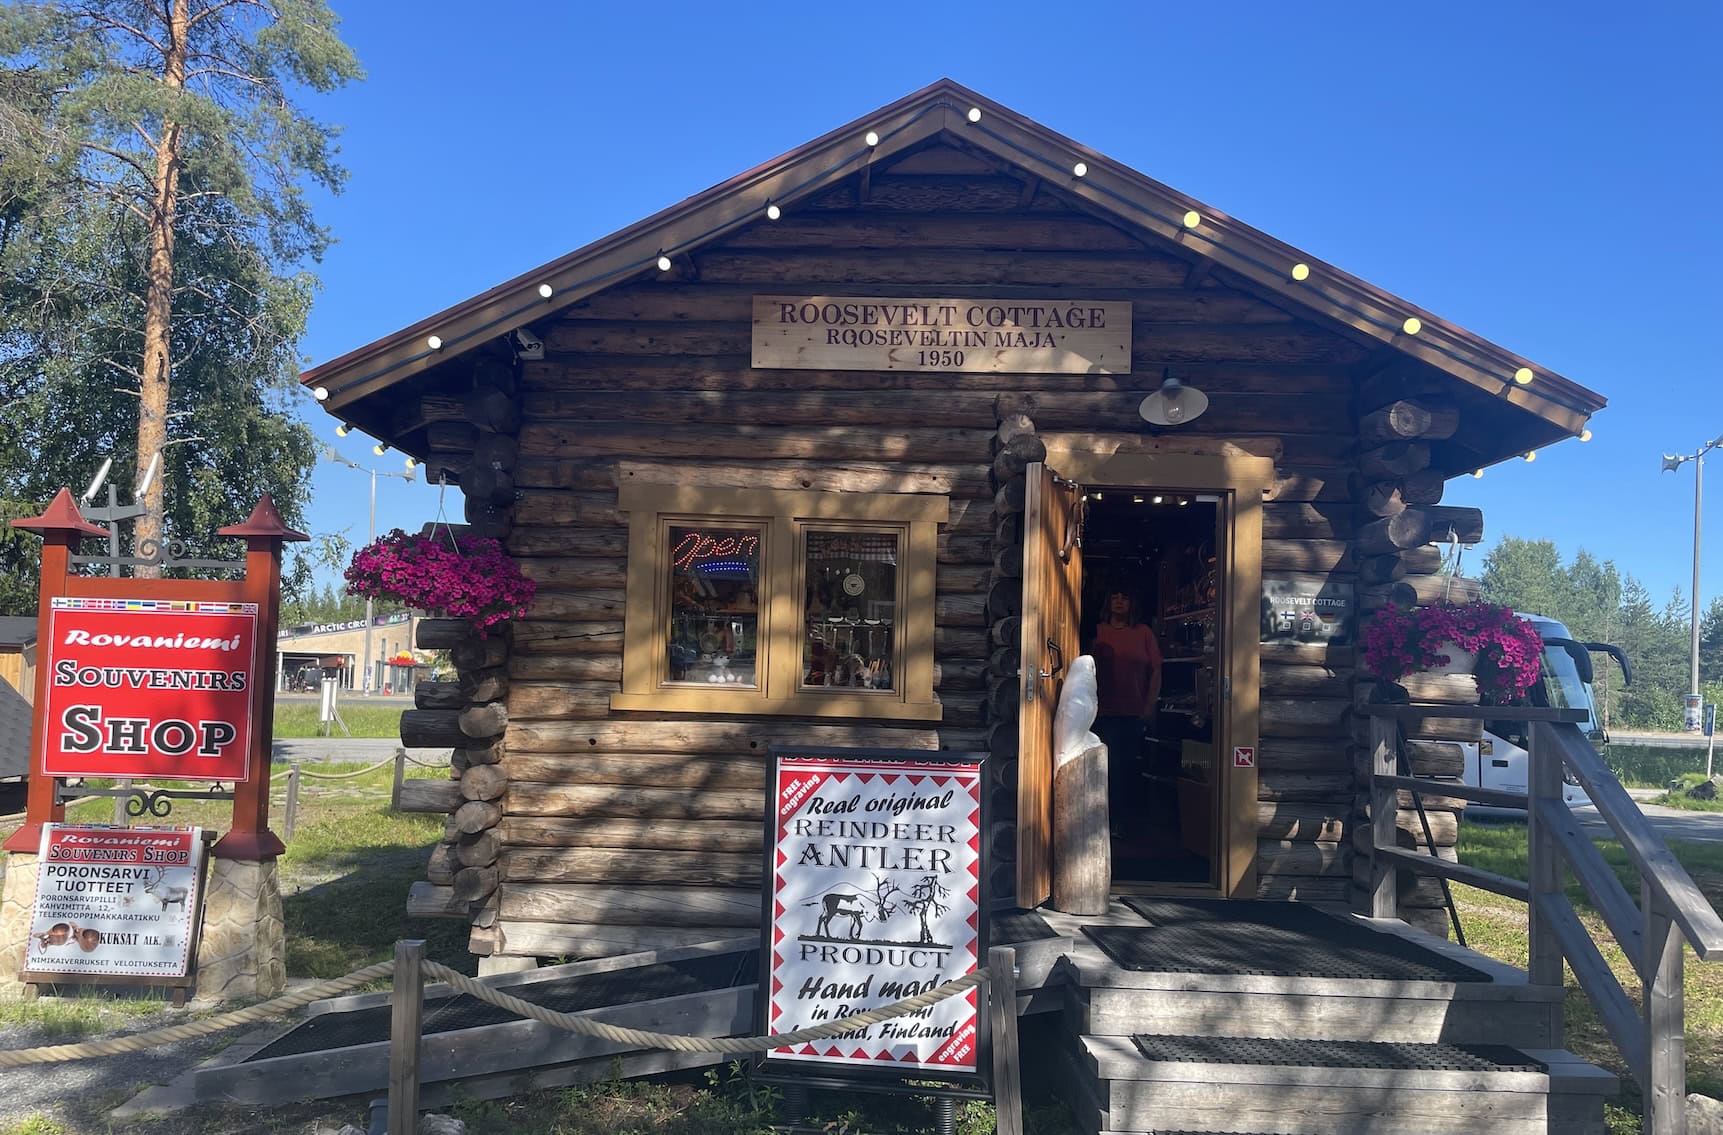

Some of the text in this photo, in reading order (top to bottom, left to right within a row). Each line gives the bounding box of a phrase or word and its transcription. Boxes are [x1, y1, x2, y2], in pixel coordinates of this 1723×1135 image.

[779, 303, 1106, 329] ROOSEVELT COTTAGE
[826, 328, 1058, 349] ROOSEVELTIN MAJA
[917, 350, 965, 367] 1950
[672, 533, 759, 572] Open
[1270, 596, 1346, 607] ROOSEVELT COTTAGE
[313, 622, 346, 634] ARCTIC
[64, 629, 241, 651] Rovaniemi
[55, 660, 247, 691] SOUVENIRS
[60, 704, 237, 757] SHOP
[780, 773, 822, 816] engraving
[782, 778, 802, 800] FREE
[807, 789, 954, 817] Real original
[60, 834, 181, 847] Rovaniemi
[793, 818, 959, 844] REINDEER
[50, 844, 189, 863] SOUVENIRS SHOP
[798, 843, 953, 874] ANTLER
[47, 866, 151, 880] PORONSARVI
[55, 880, 135, 894] TUOTTEET
[39, 903, 91, 911] KAHVIMITTA
[40, 894, 117, 904] PORONSARVIPILLI
[39, 911, 160, 922] TELESKOOPPIMAKKARATIKKU
[99, 932, 139, 945] KUKSAT
[143, 935, 161, 946] ALK.
[31, 957, 178, 969] NIMIKAIVERRUKSET VELOITUKSETTA
[799, 943, 951, 969] PRODUCT
[797, 974, 875, 1000] Hand
[811, 1004, 829, 1020] in
[878, 1020, 959, 1039] Finland
[938, 1024, 976, 1062] engraving
[953, 1044, 972, 1063] FREE
